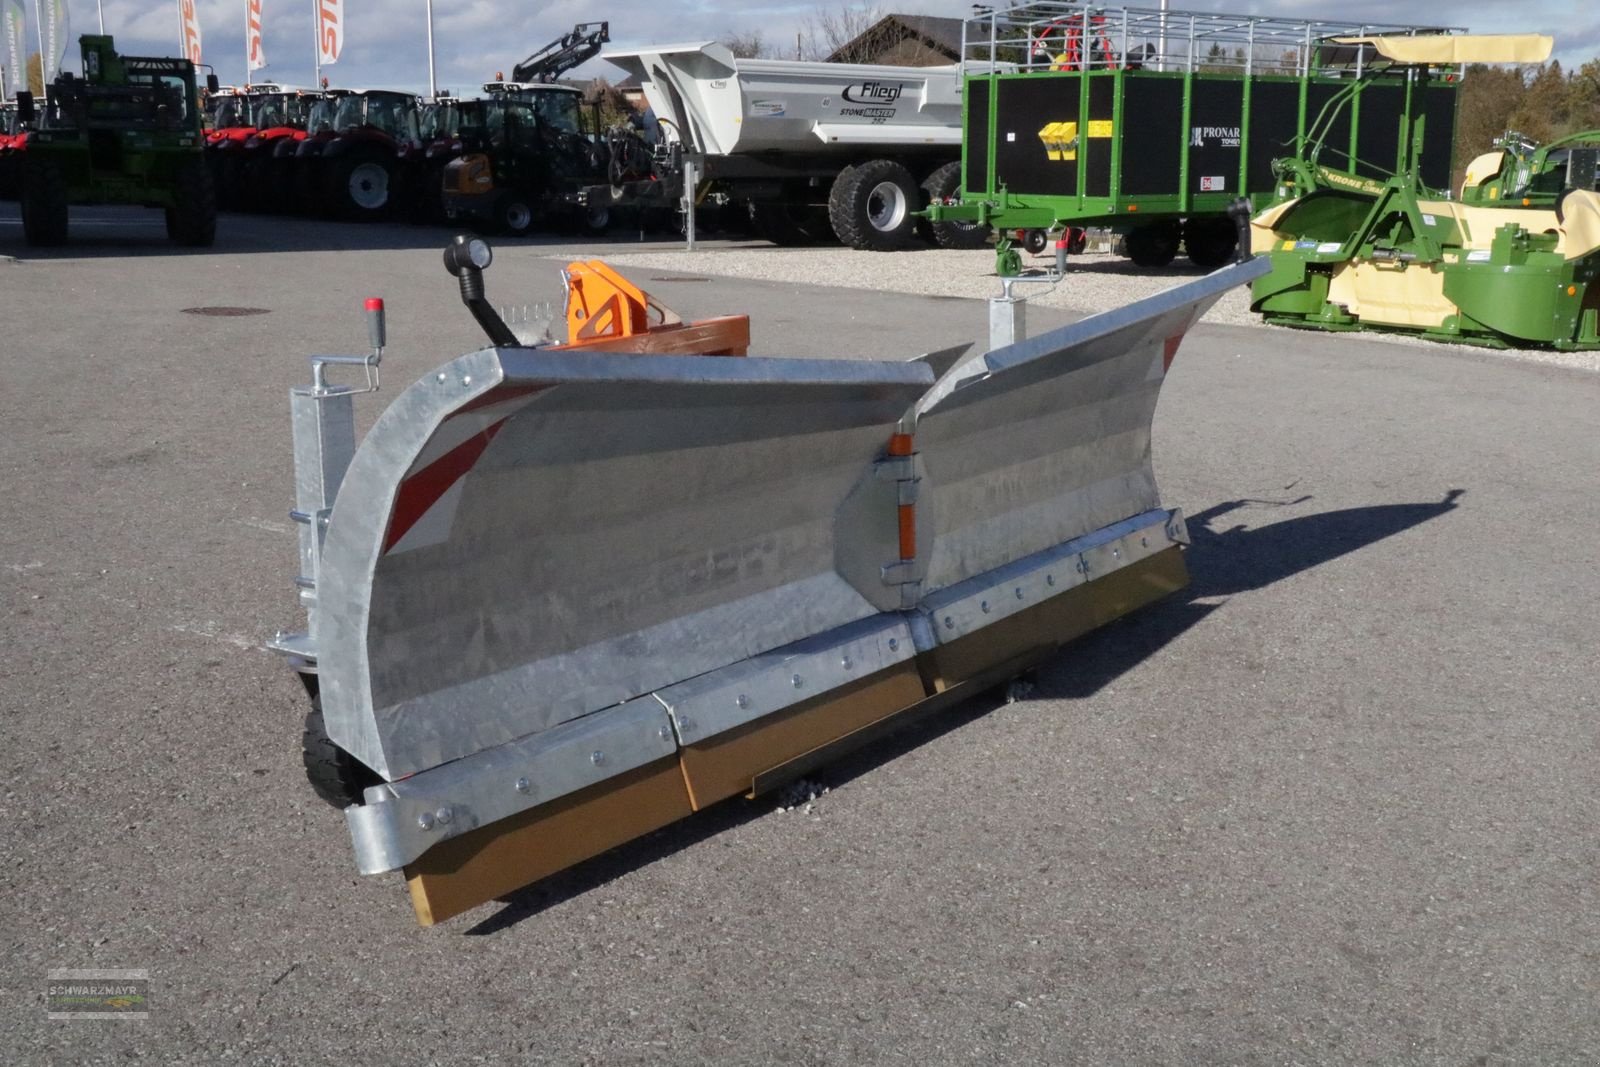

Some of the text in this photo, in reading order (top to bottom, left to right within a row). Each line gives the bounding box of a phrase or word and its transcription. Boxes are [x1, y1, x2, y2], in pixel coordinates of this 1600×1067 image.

[6, 12, 20, 85] SCHWARZMAYR
[860, 82, 903, 102] Fliegl
[1203, 127, 1240, 138] PRONAR
[1327, 173, 1363, 189] KRONE
